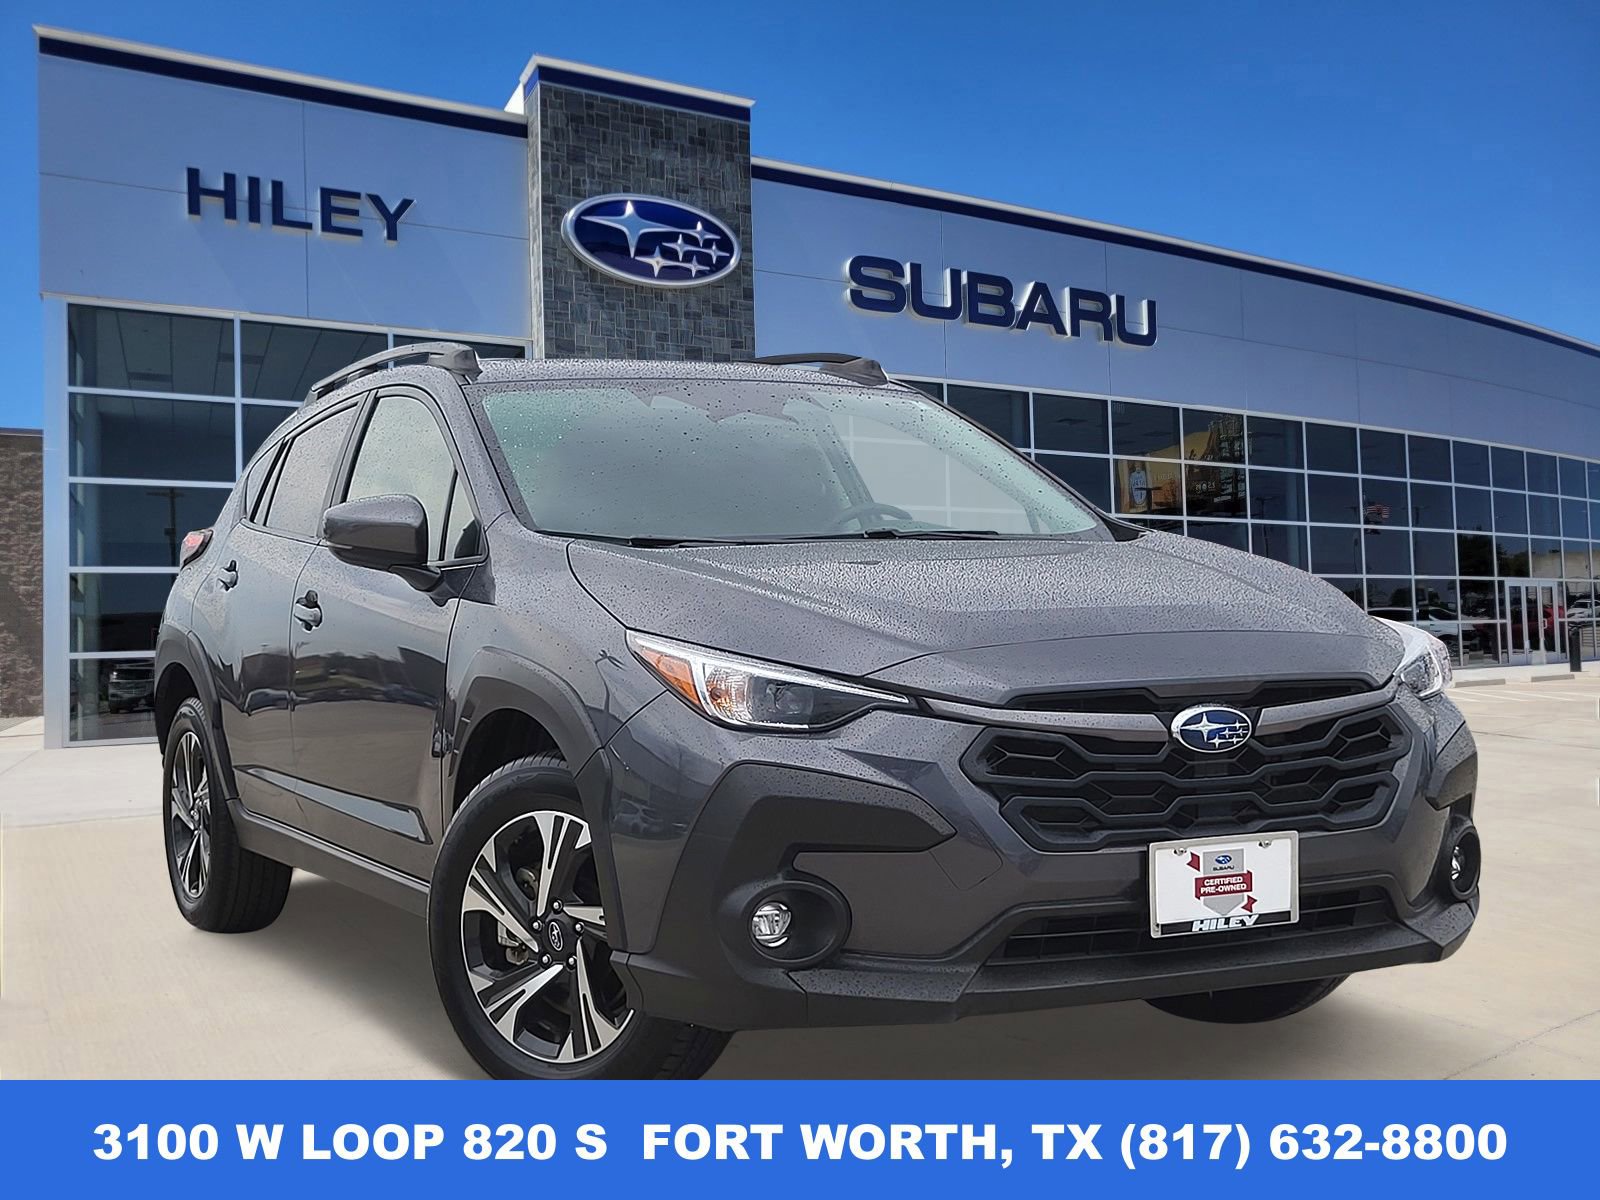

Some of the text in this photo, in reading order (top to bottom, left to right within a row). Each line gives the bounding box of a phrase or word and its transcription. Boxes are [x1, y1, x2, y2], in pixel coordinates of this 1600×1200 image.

[187, 167, 415, 242] HILEY
[847, 254, 1158, 348] SUBARU
[1200, 883, 1247, 894] PRE-OWNED
[1204, 876, 1243, 886] CERTIFIED
[1192, 914, 1259, 931] HILEY
